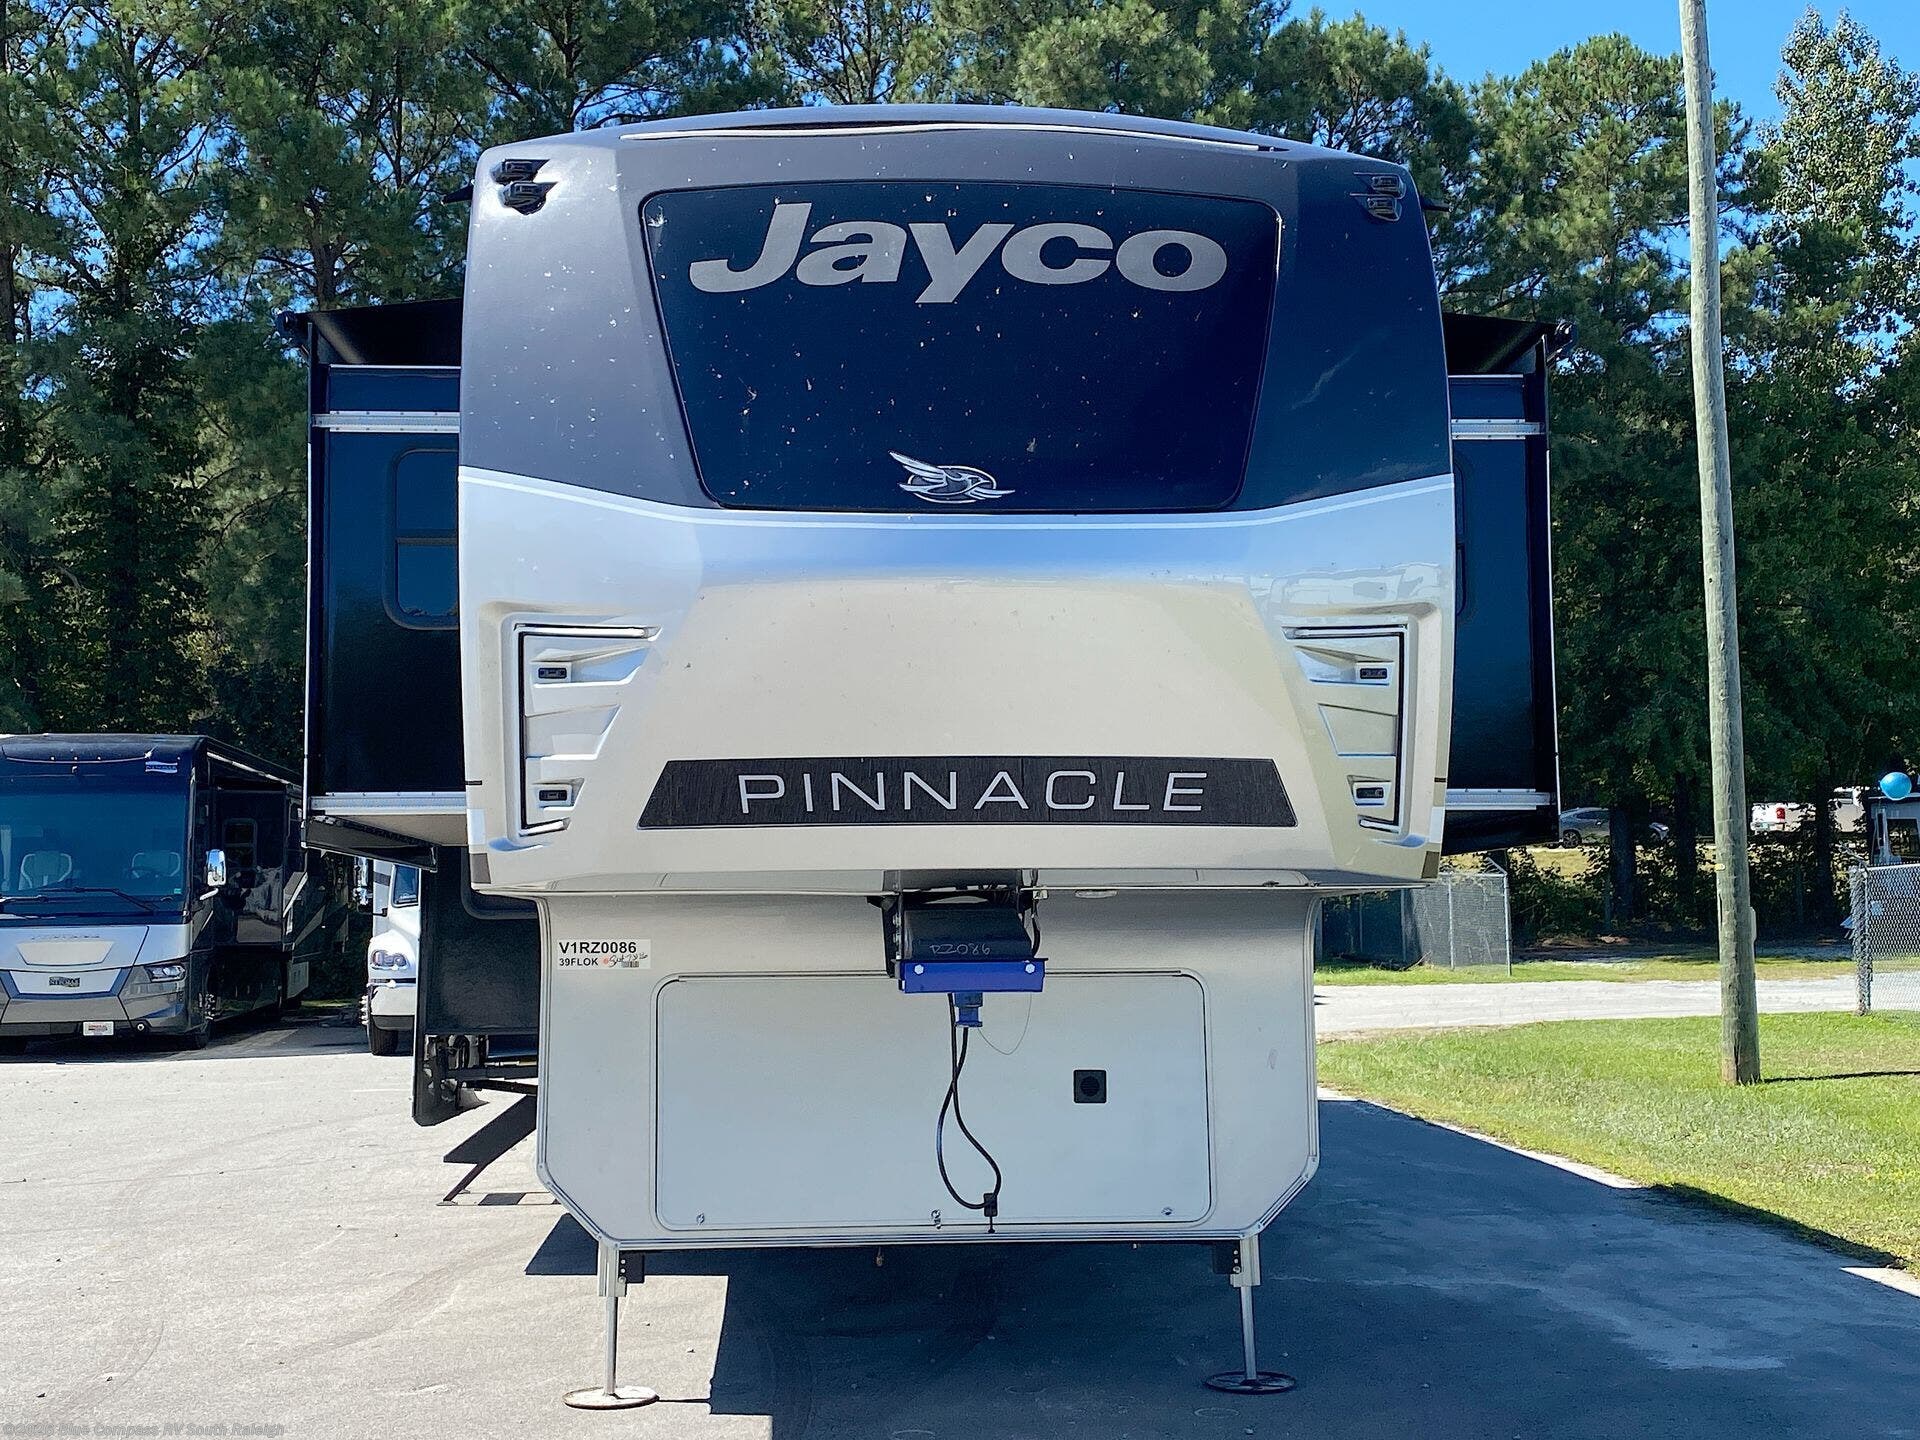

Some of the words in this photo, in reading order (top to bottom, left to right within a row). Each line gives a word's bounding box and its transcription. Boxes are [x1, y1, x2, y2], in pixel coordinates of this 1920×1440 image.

[689, 202, 1228, 303] Jayco
[738, 770, 1207, 814] PINNACLE
[558, 941, 637, 954] V1RZ0086
[559, 957, 599, 967] 39FLOK
